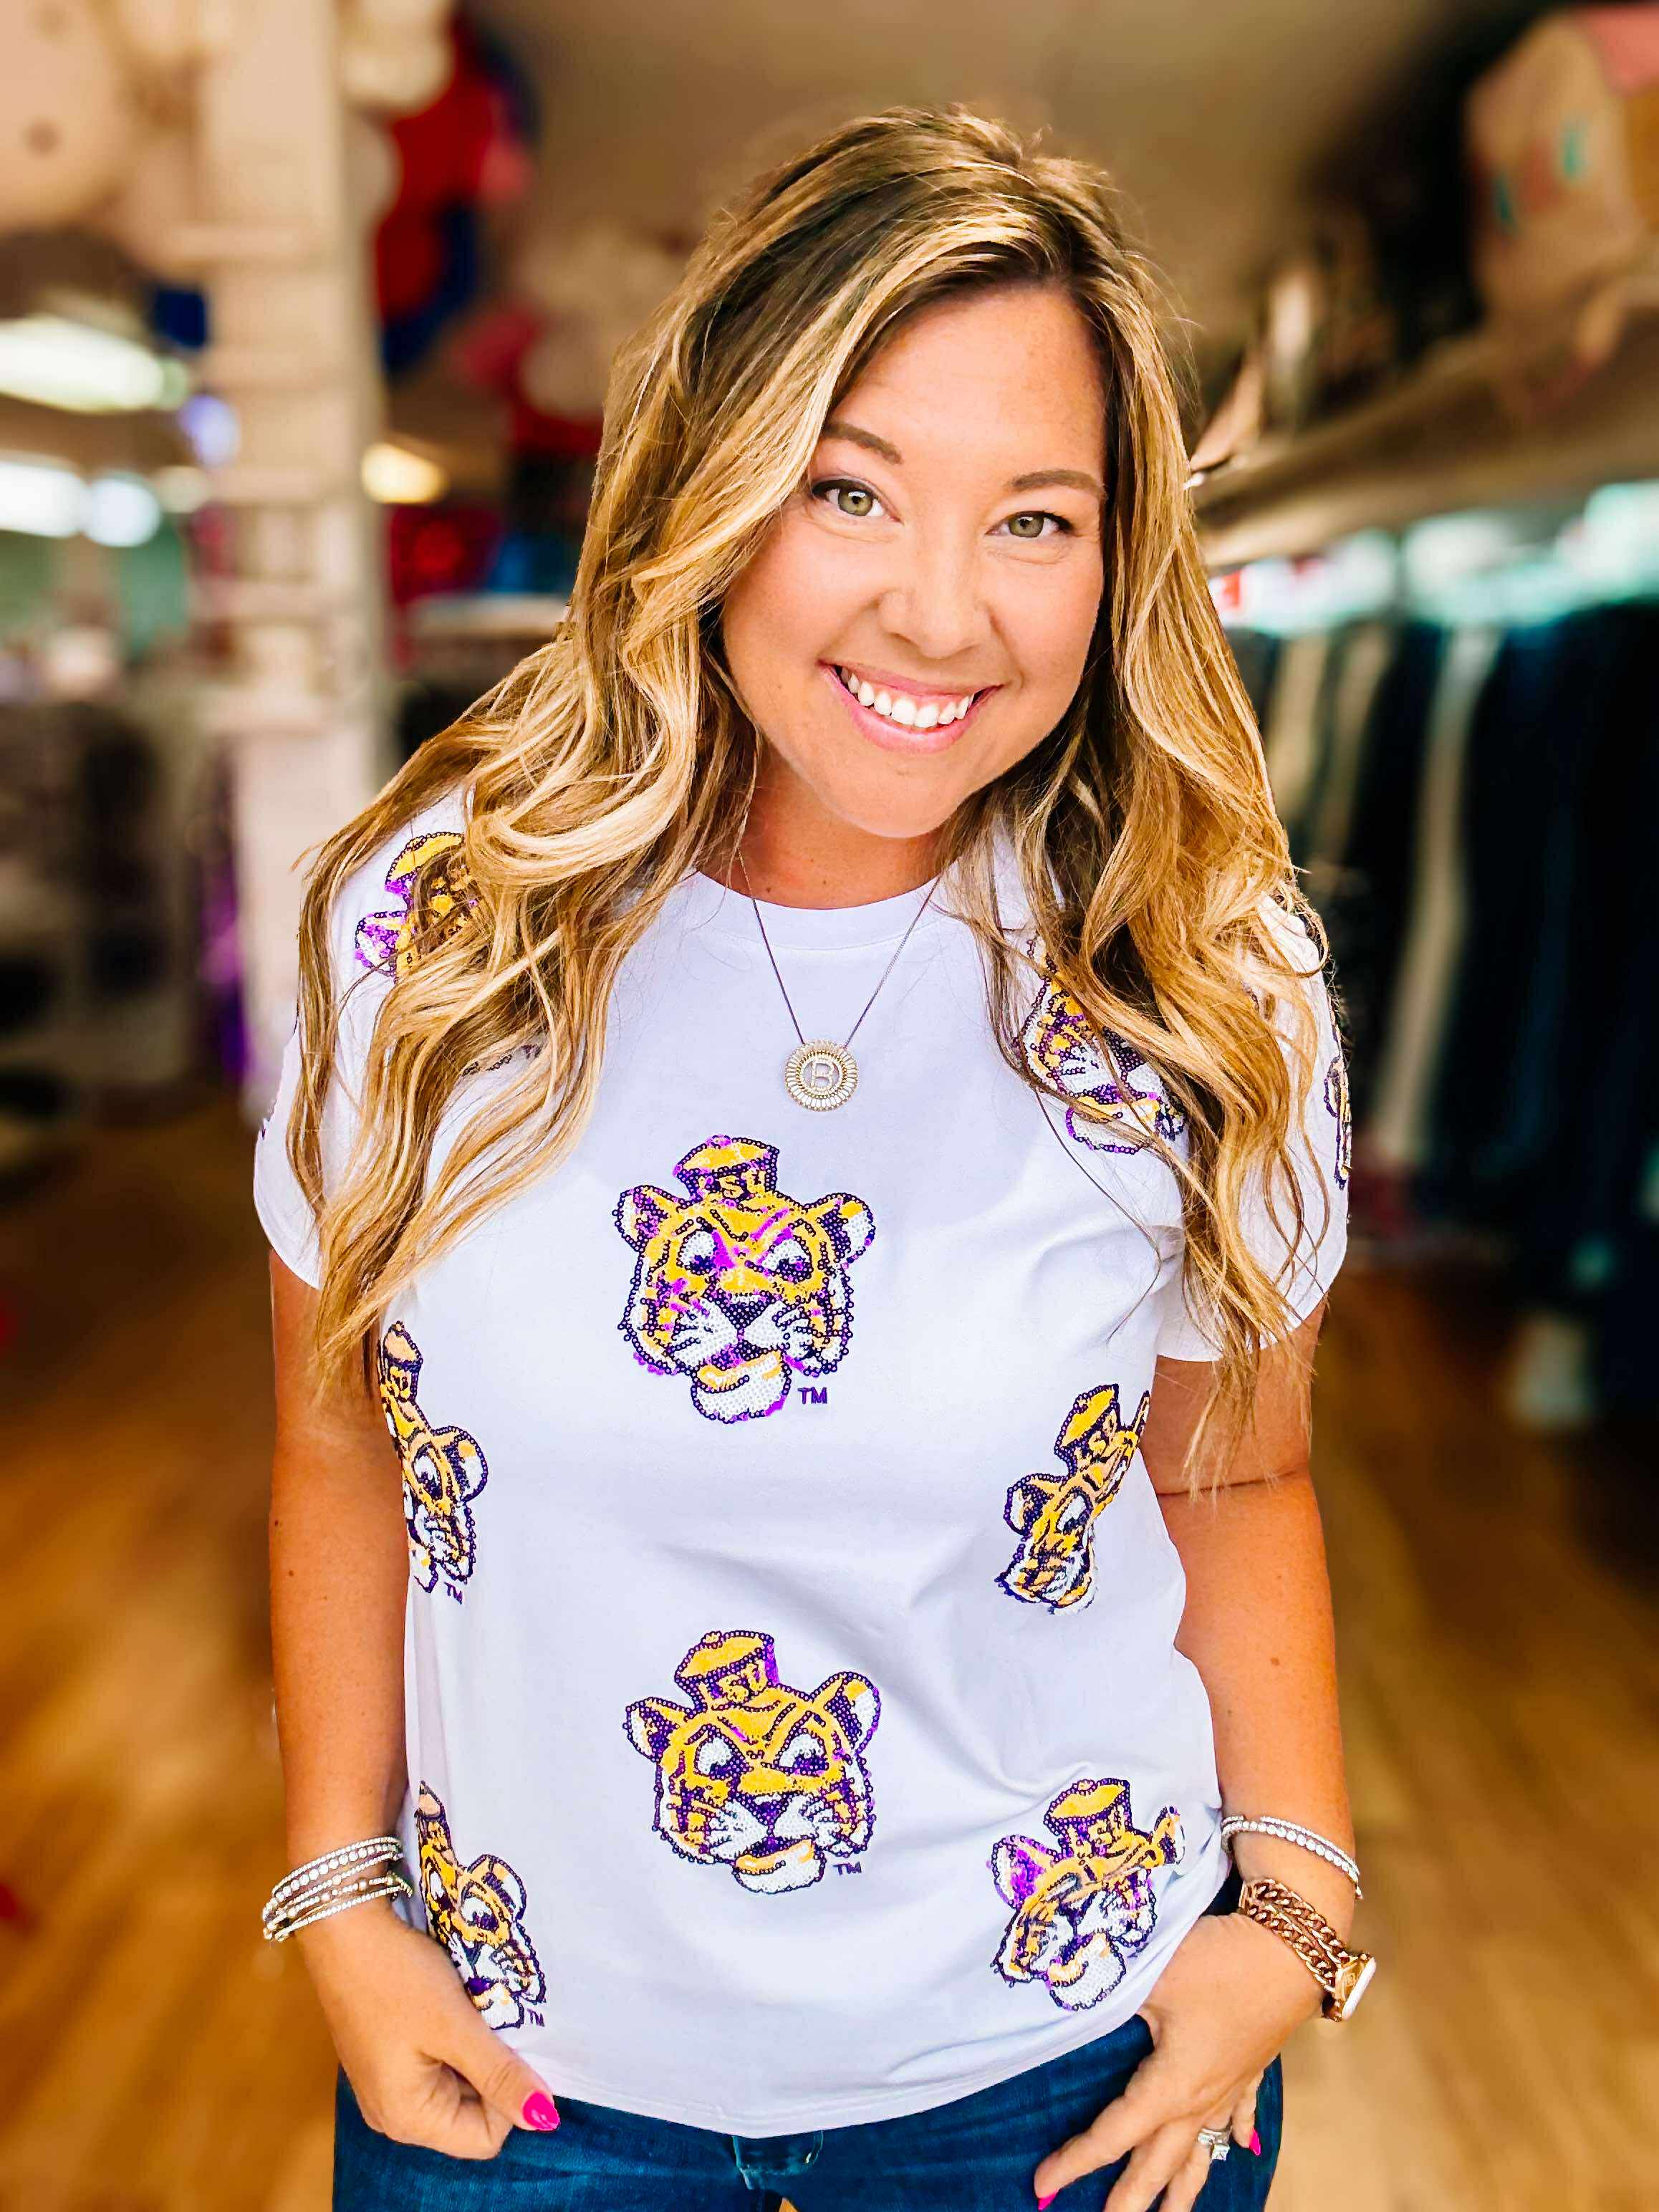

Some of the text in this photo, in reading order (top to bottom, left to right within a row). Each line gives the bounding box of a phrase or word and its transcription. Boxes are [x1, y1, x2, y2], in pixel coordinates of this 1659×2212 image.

[811, 1059, 834, 1090] B
[797, 1386, 827, 1405] TM
[833, 1861, 862, 1875] TM
